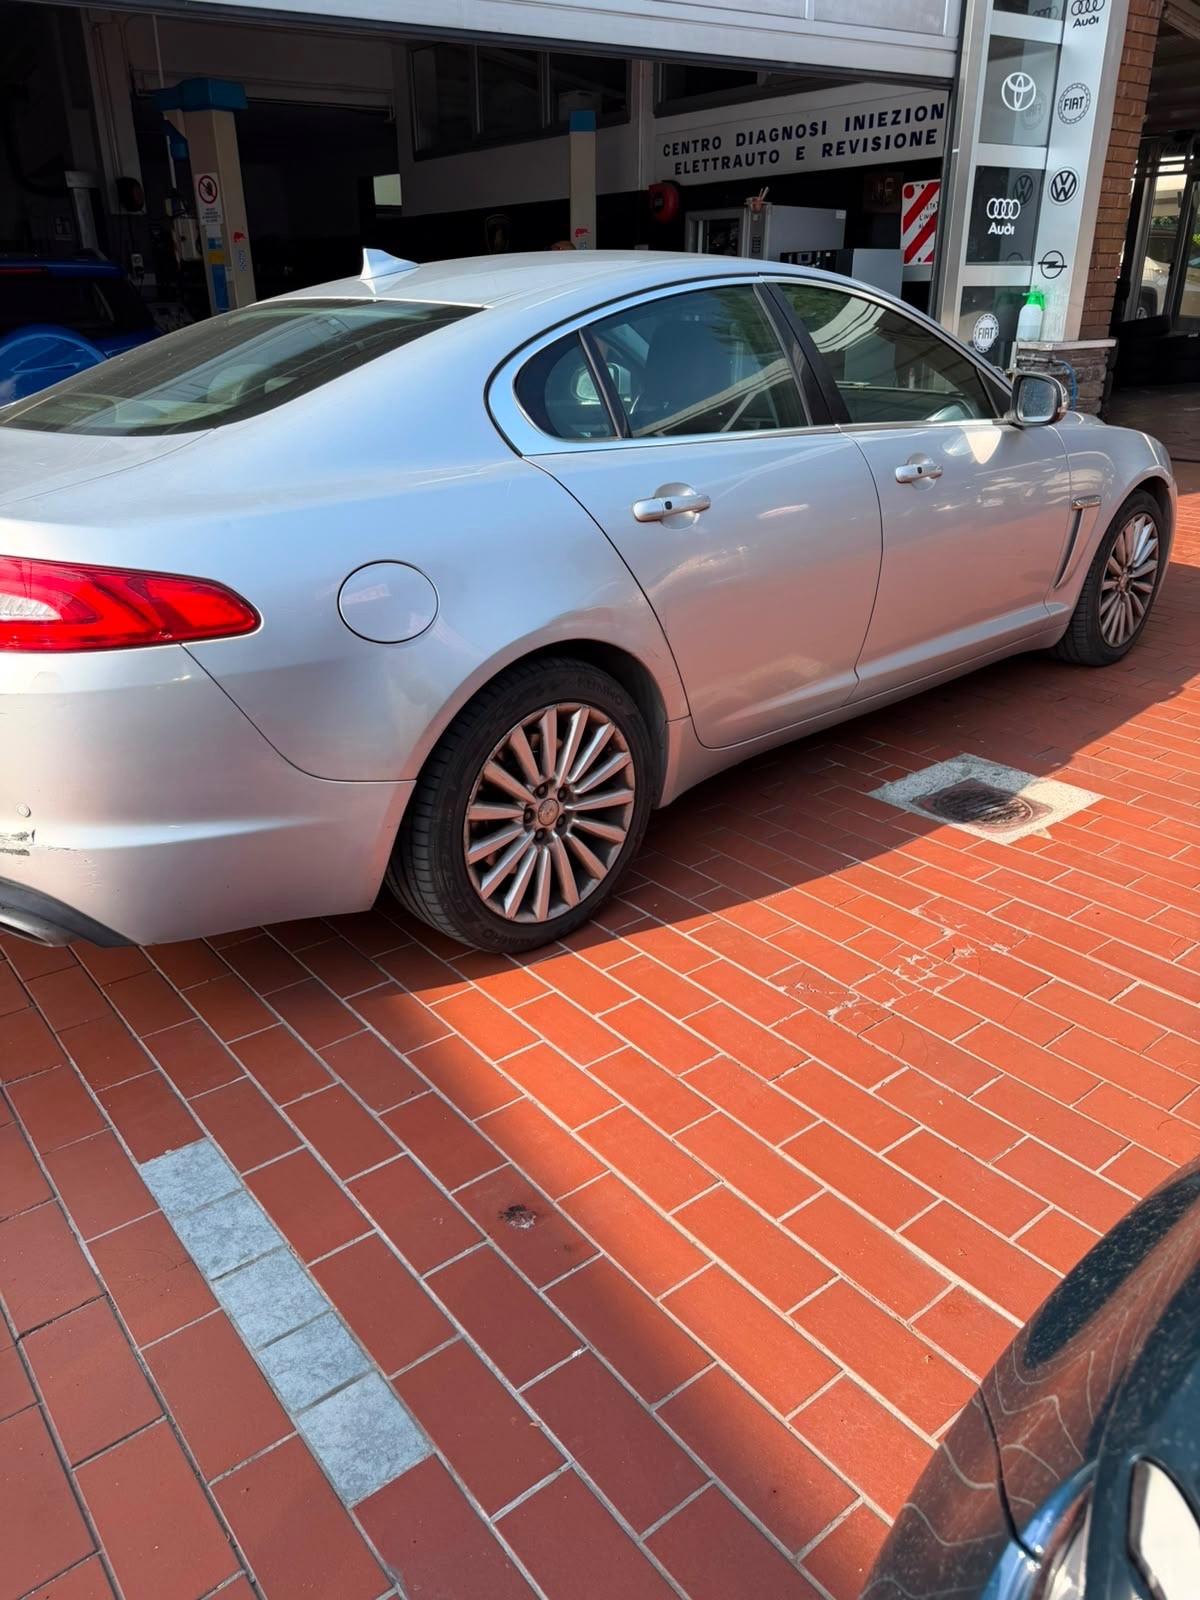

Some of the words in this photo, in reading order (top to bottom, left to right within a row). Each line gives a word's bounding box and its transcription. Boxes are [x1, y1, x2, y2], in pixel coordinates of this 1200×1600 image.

[1072, 15, 1099, 29] Audi
[1063, 96, 1085, 112] FIAT
[663, 136, 722, 158] CENTRO
[736, 120, 828, 147] DIAGNOSI
[674, 149, 780, 176] ELETTRAUTO
[795, 146, 806, 161] E
[821, 128, 938, 158] REVISIONE
[987, 222, 1015, 236] Audi
[977, 326, 995, 340] FIAT
